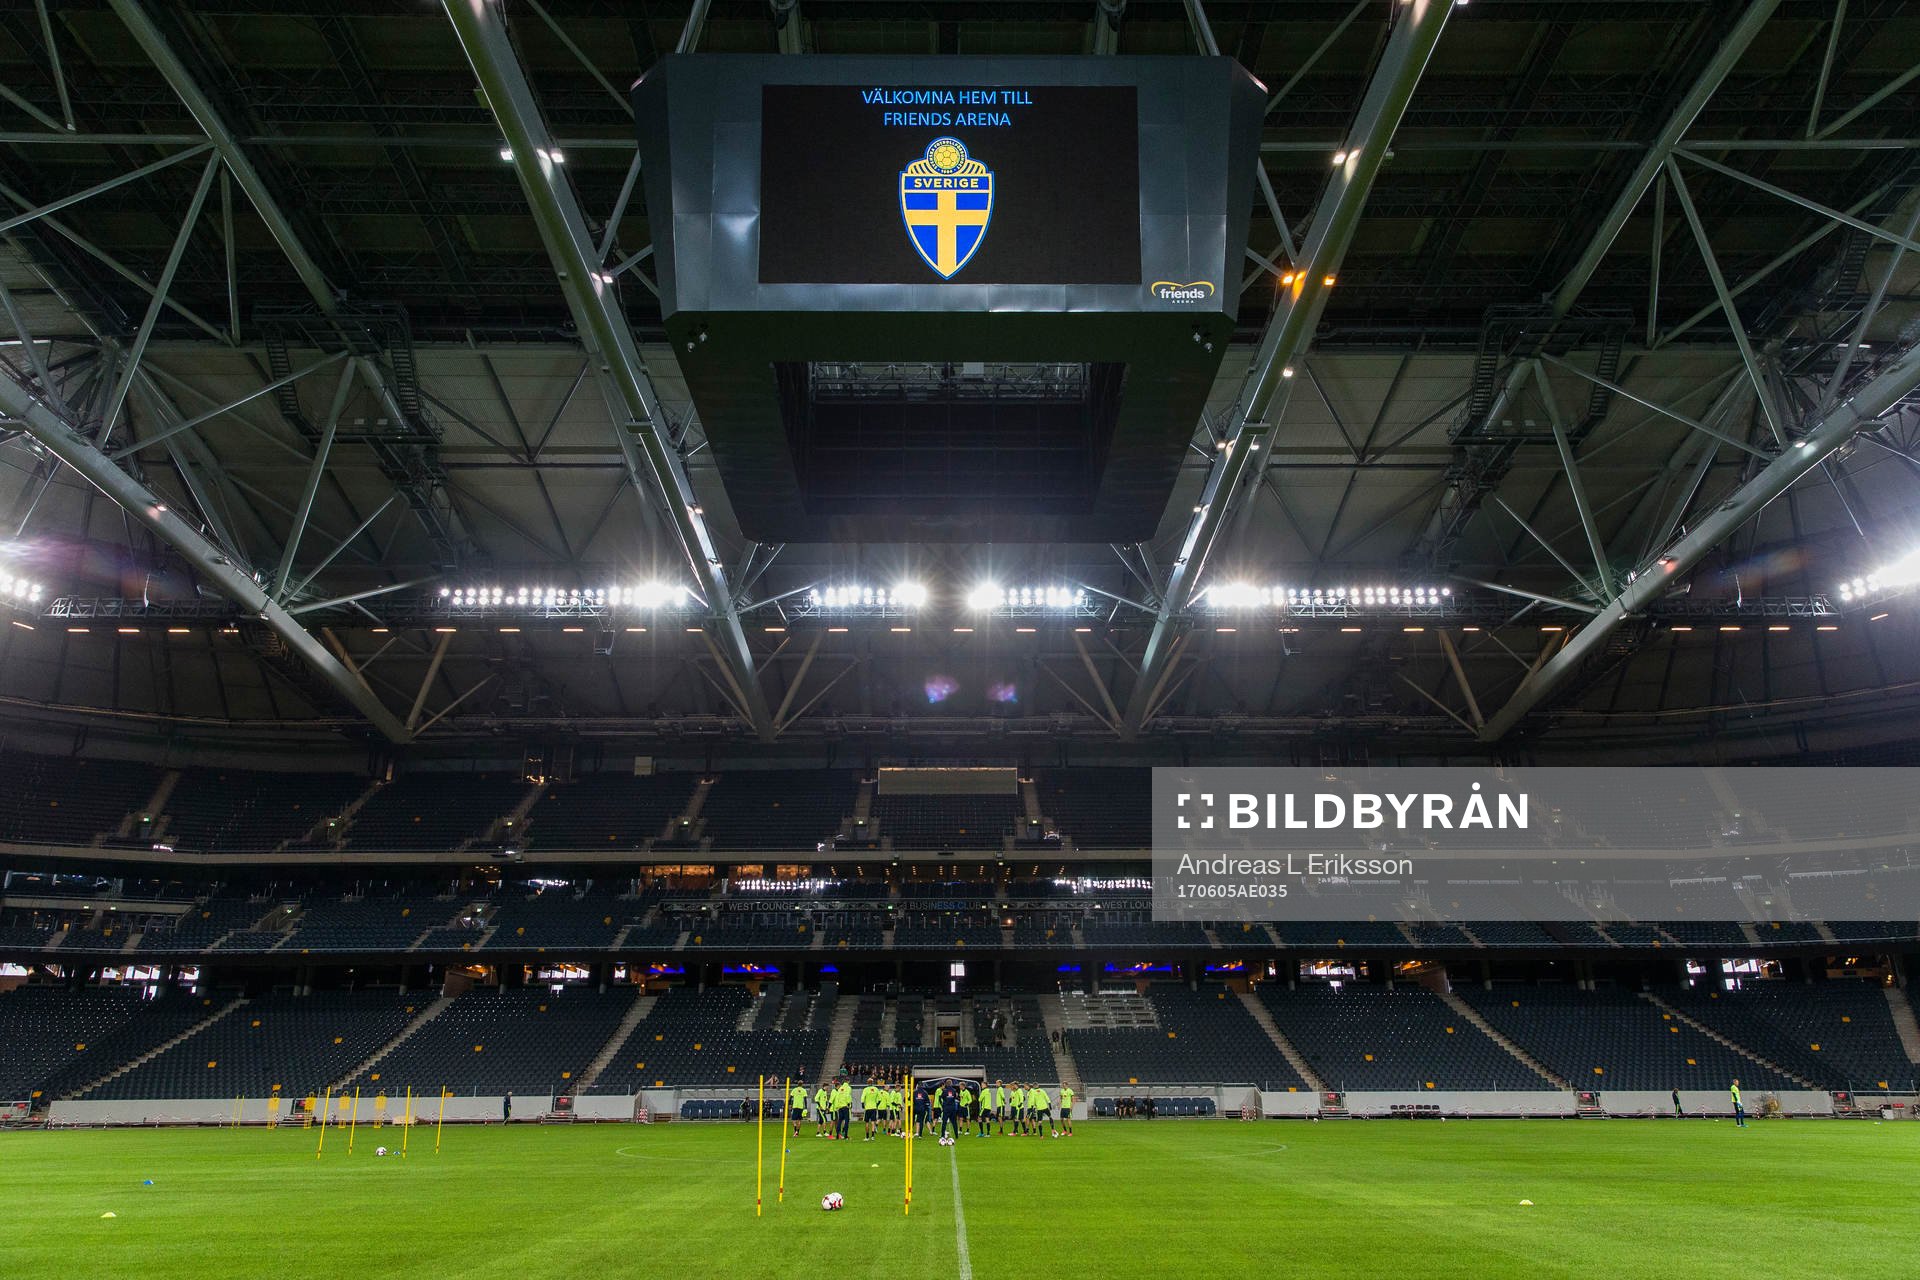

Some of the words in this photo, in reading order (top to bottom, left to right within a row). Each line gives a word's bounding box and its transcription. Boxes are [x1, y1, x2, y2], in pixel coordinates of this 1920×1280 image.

[862, 88, 955, 105] VÄLKOMNA
[959, 91, 997, 105] HEM
[1001, 91, 1033, 105] TILL
[884, 112, 951, 127] FRIENDS
[955, 112, 1012, 127] ARENA
[914, 178, 979, 188] SVERIGE
[1160, 286, 1205, 299] friends
[728, 902, 755, 911] WEST
[757, 902, 794, 911] LOUNGE
[909, 901, 956, 910] BUSINESS
[957, 901, 982, 910] CLUB
[1103, 901, 1129, 910] WEST
